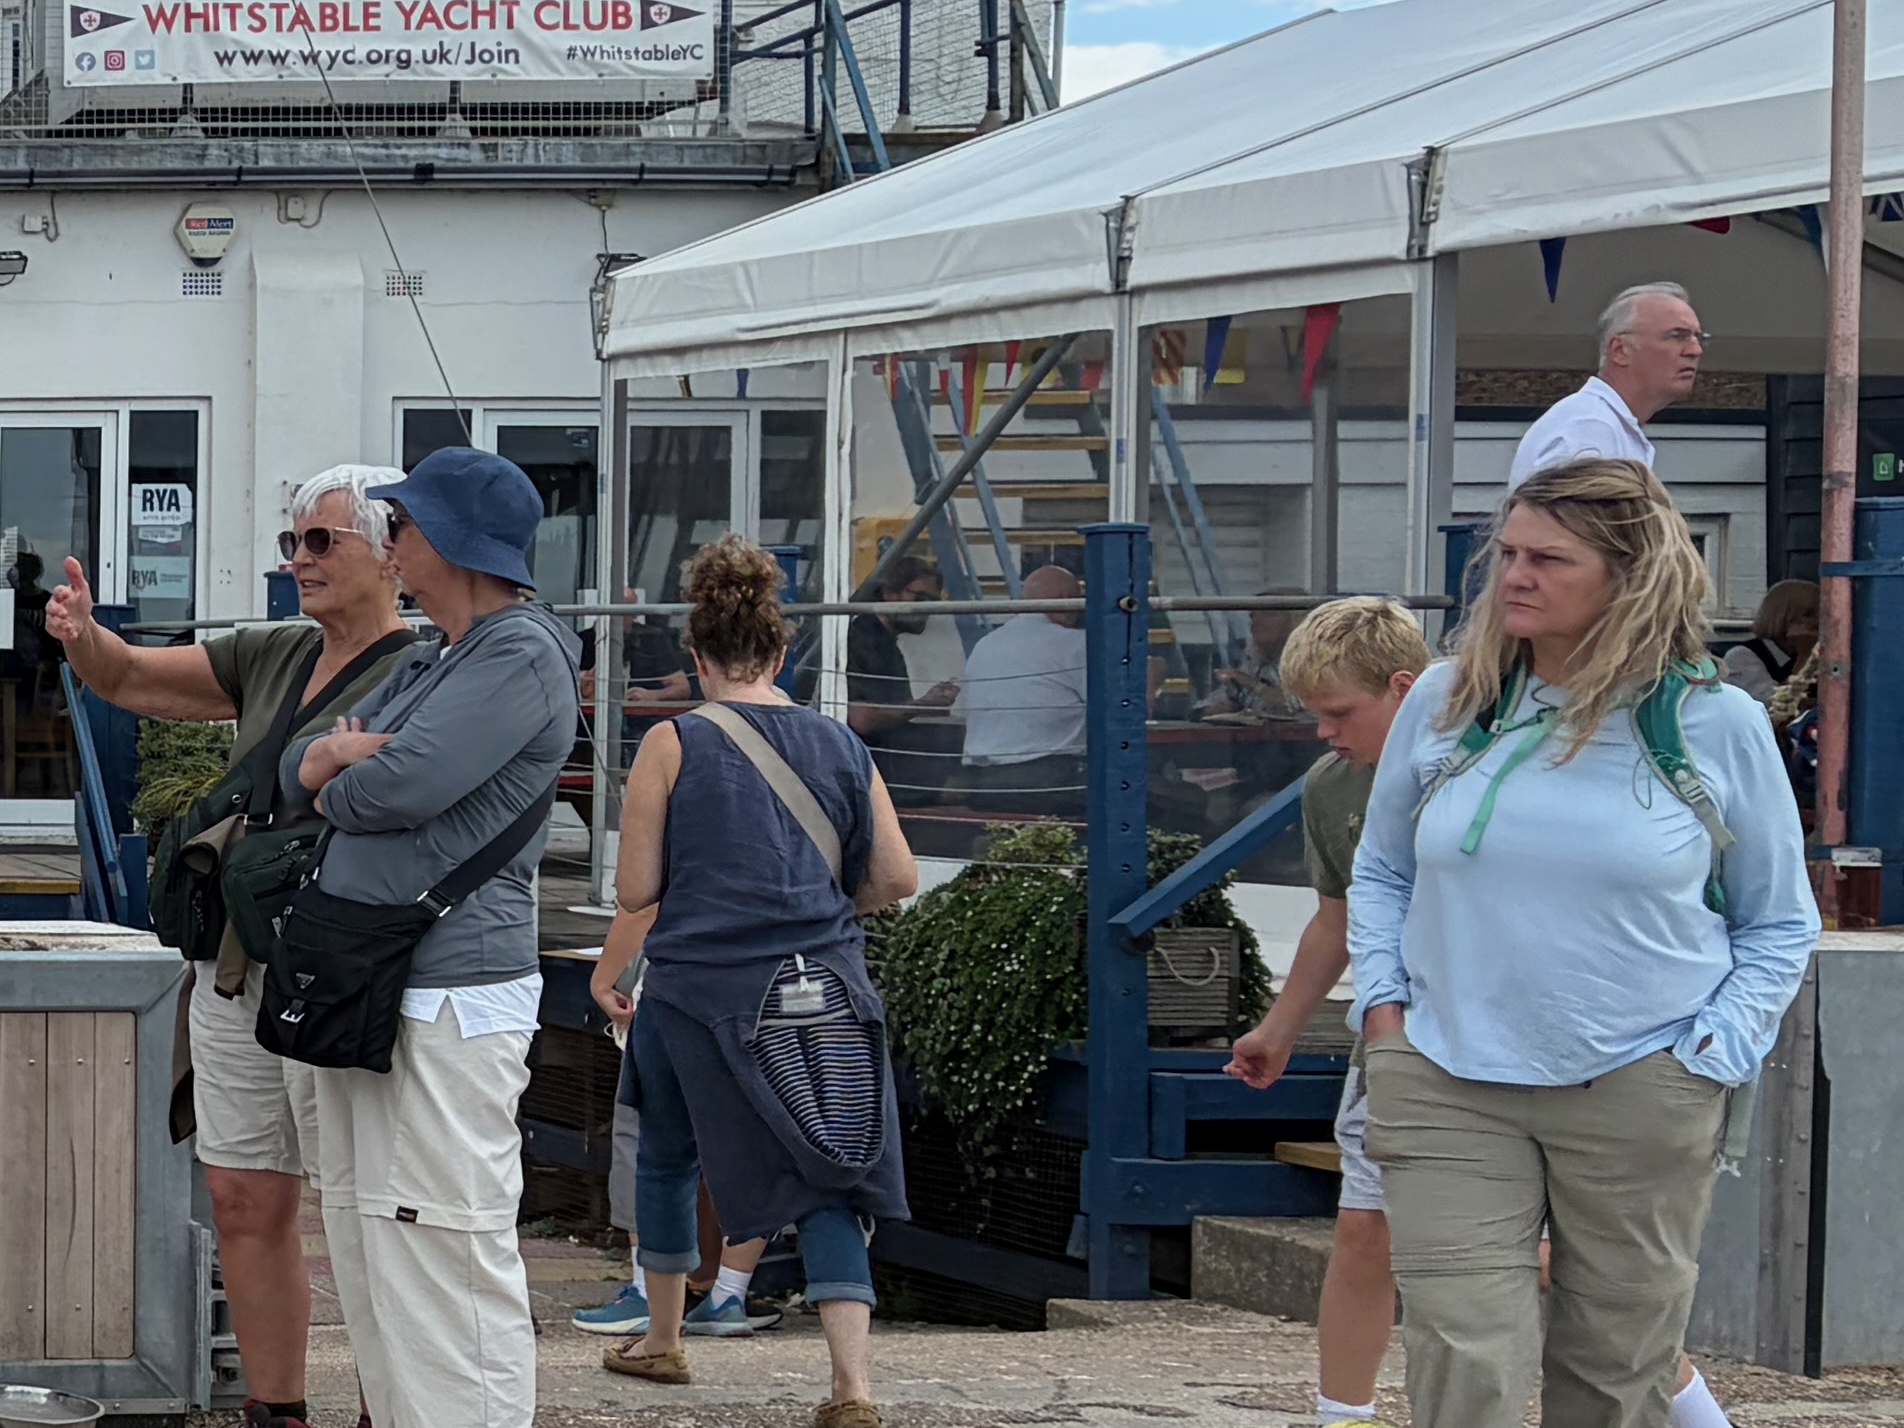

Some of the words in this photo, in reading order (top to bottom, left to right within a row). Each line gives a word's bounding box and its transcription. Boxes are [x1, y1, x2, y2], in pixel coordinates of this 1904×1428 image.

[142, 1, 381, 35] WHITSTABLE
[394, 0, 520, 31] YACHT
[533, 0, 633, 31] CLUB
[214, 41, 520, 69] www.wyc.org.uk/Join
[566, 43, 704, 61] #WhitstableYC
[142, 488, 181, 512] RYA
[131, 569, 158, 586] RYA
